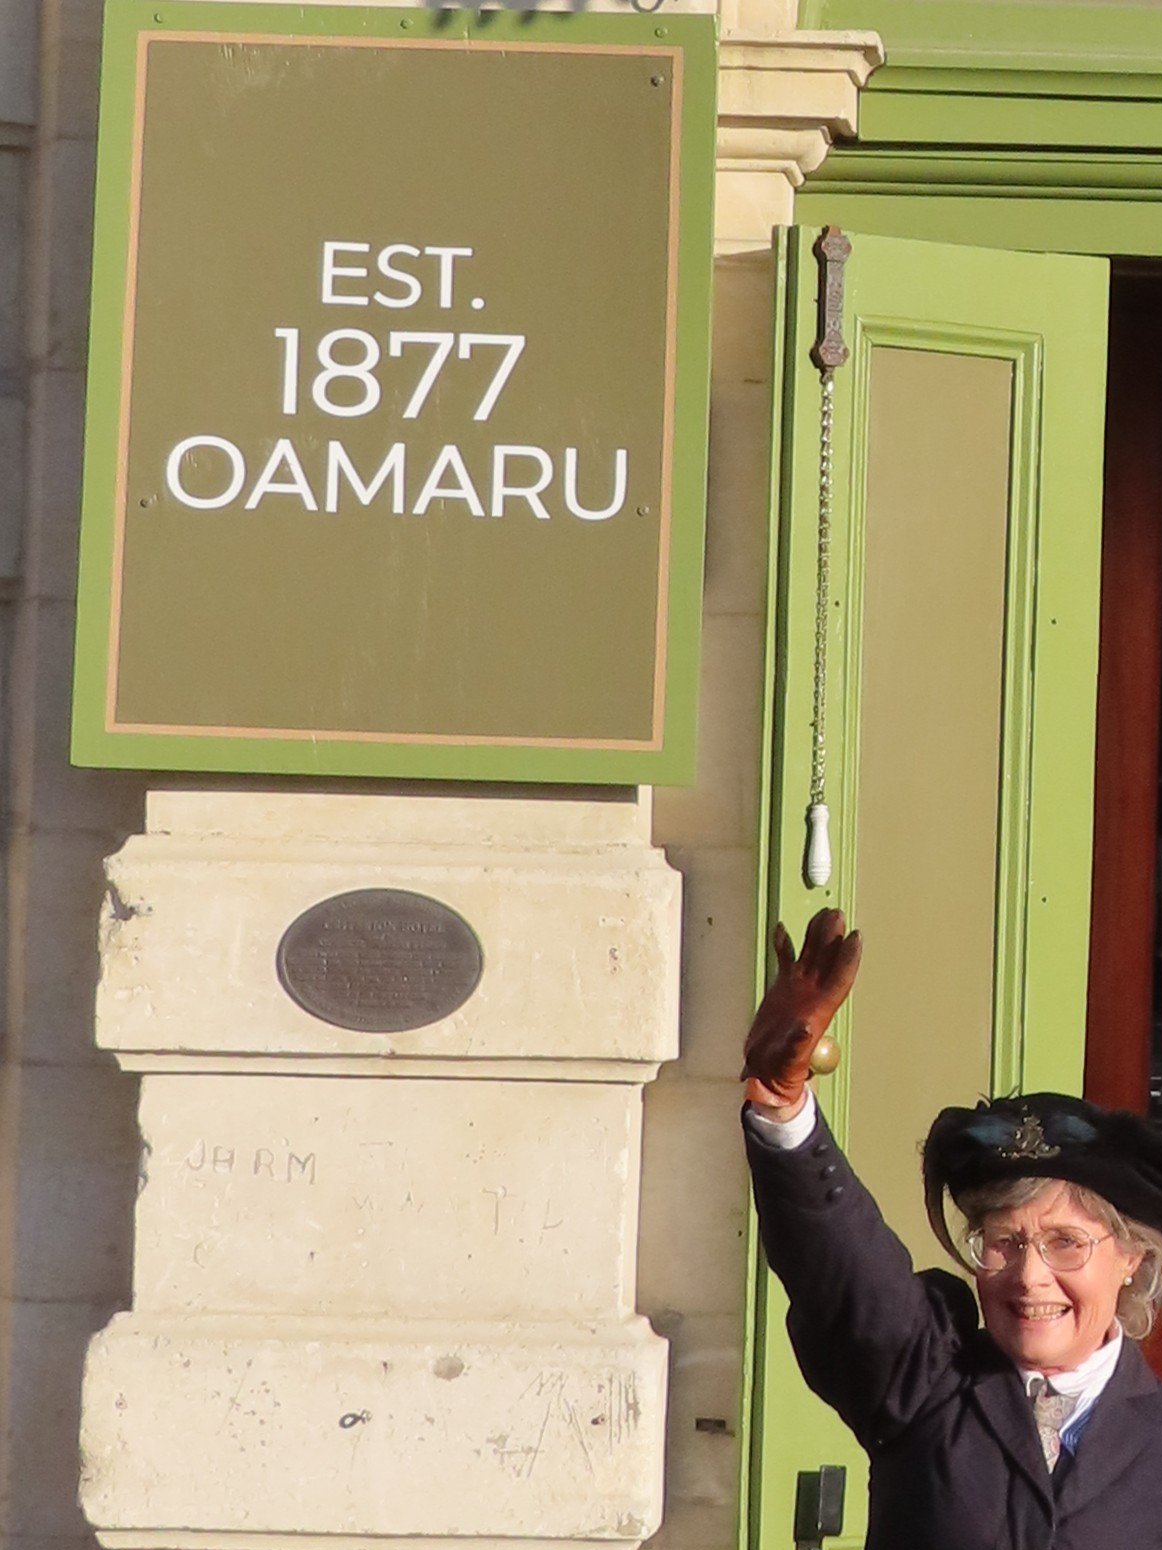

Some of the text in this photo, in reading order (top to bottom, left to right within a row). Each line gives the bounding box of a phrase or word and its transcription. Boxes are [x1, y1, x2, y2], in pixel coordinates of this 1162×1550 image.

[320, 240, 486, 311] EST.
[273, 326, 526, 422] 1877
[165, 434, 628, 522] OAMARU
